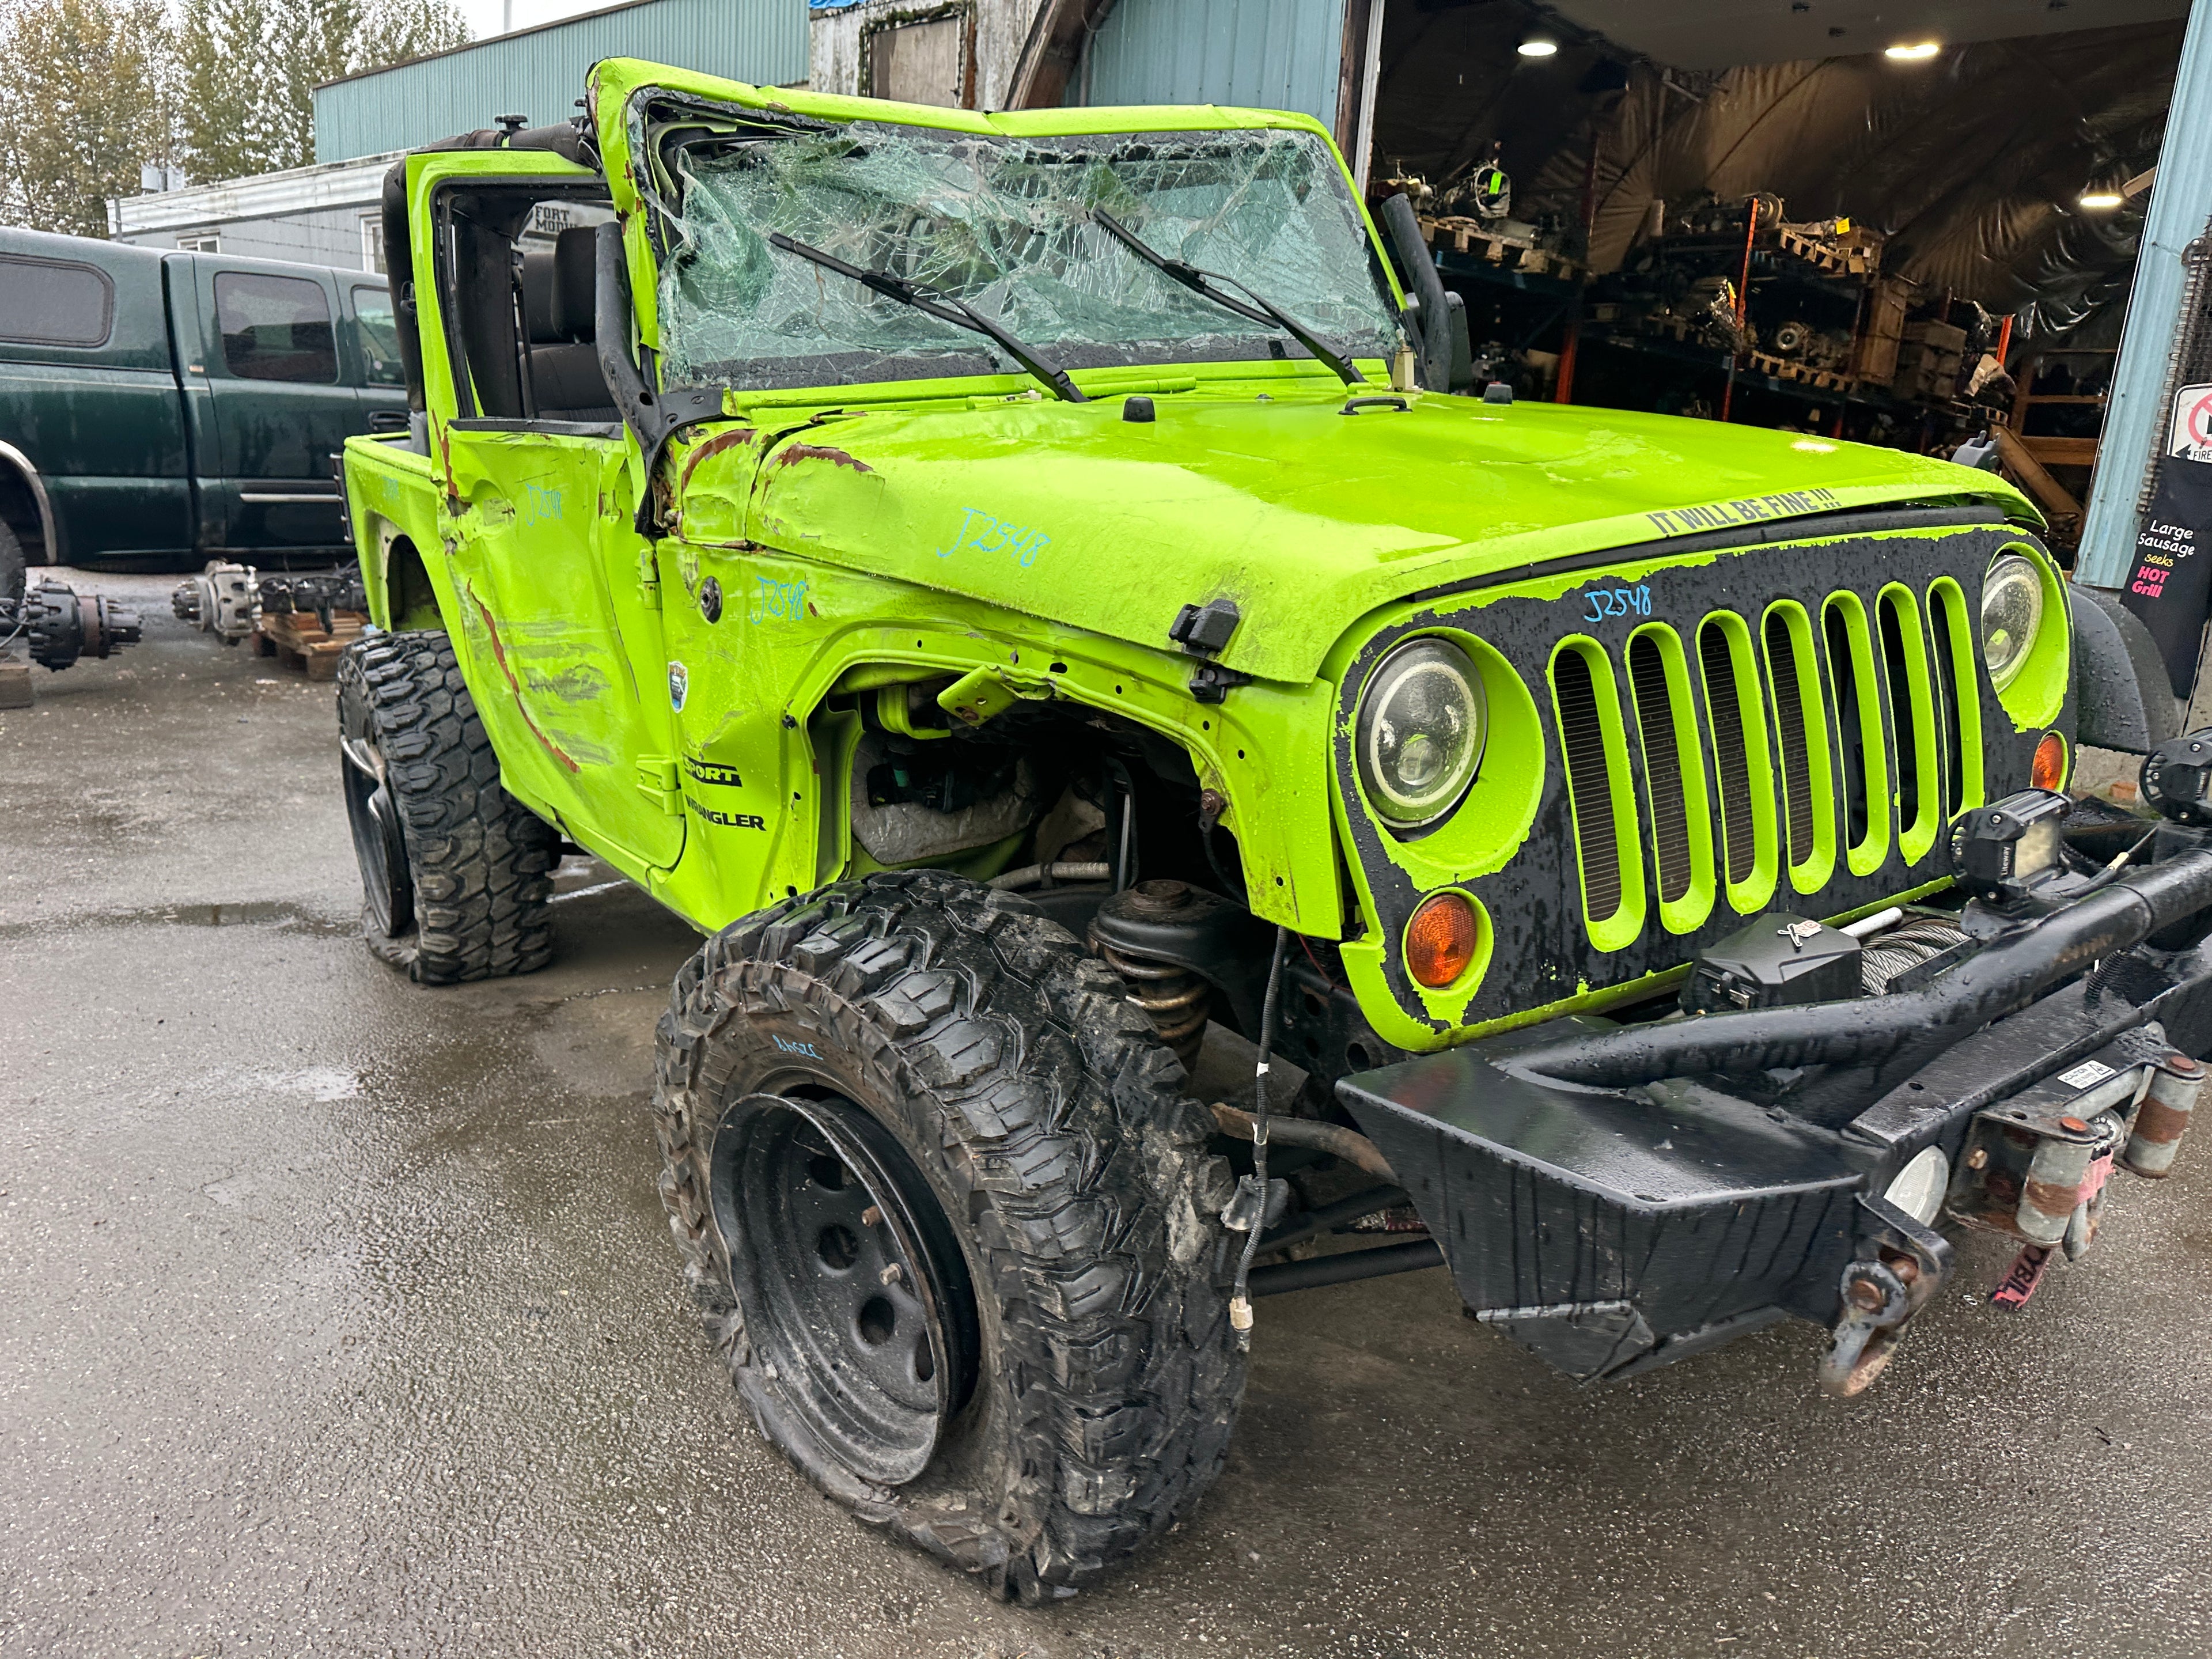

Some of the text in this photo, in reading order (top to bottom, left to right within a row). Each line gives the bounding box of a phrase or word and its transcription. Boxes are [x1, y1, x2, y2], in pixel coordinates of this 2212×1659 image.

[535, 205, 570, 221] FORT
[2193, 450, 2212, 460] FIRE
[525, 483, 562, 527] J2548
[1646, 512, 1679, 534] IT
[1671, 505, 1740, 529] WILL
[1729, 499, 1771, 521] BE
[1760, 491, 1820, 516] FINE
[937, 507, 1051, 567] J2548
[2150, 520, 2194, 541] Large
[2138, 533, 2195, 558] Sausage
[2144, 554, 2173, 567] seeks
[2137, 566, 2170, 584] HOT
[751, 576, 808, 624] J2548
[2132, 580, 2163, 598] Grill
[1584, 584, 1652, 622] J2548
[683, 756, 738, 782] SPORT
[685, 794, 767, 831] WRANGLER
